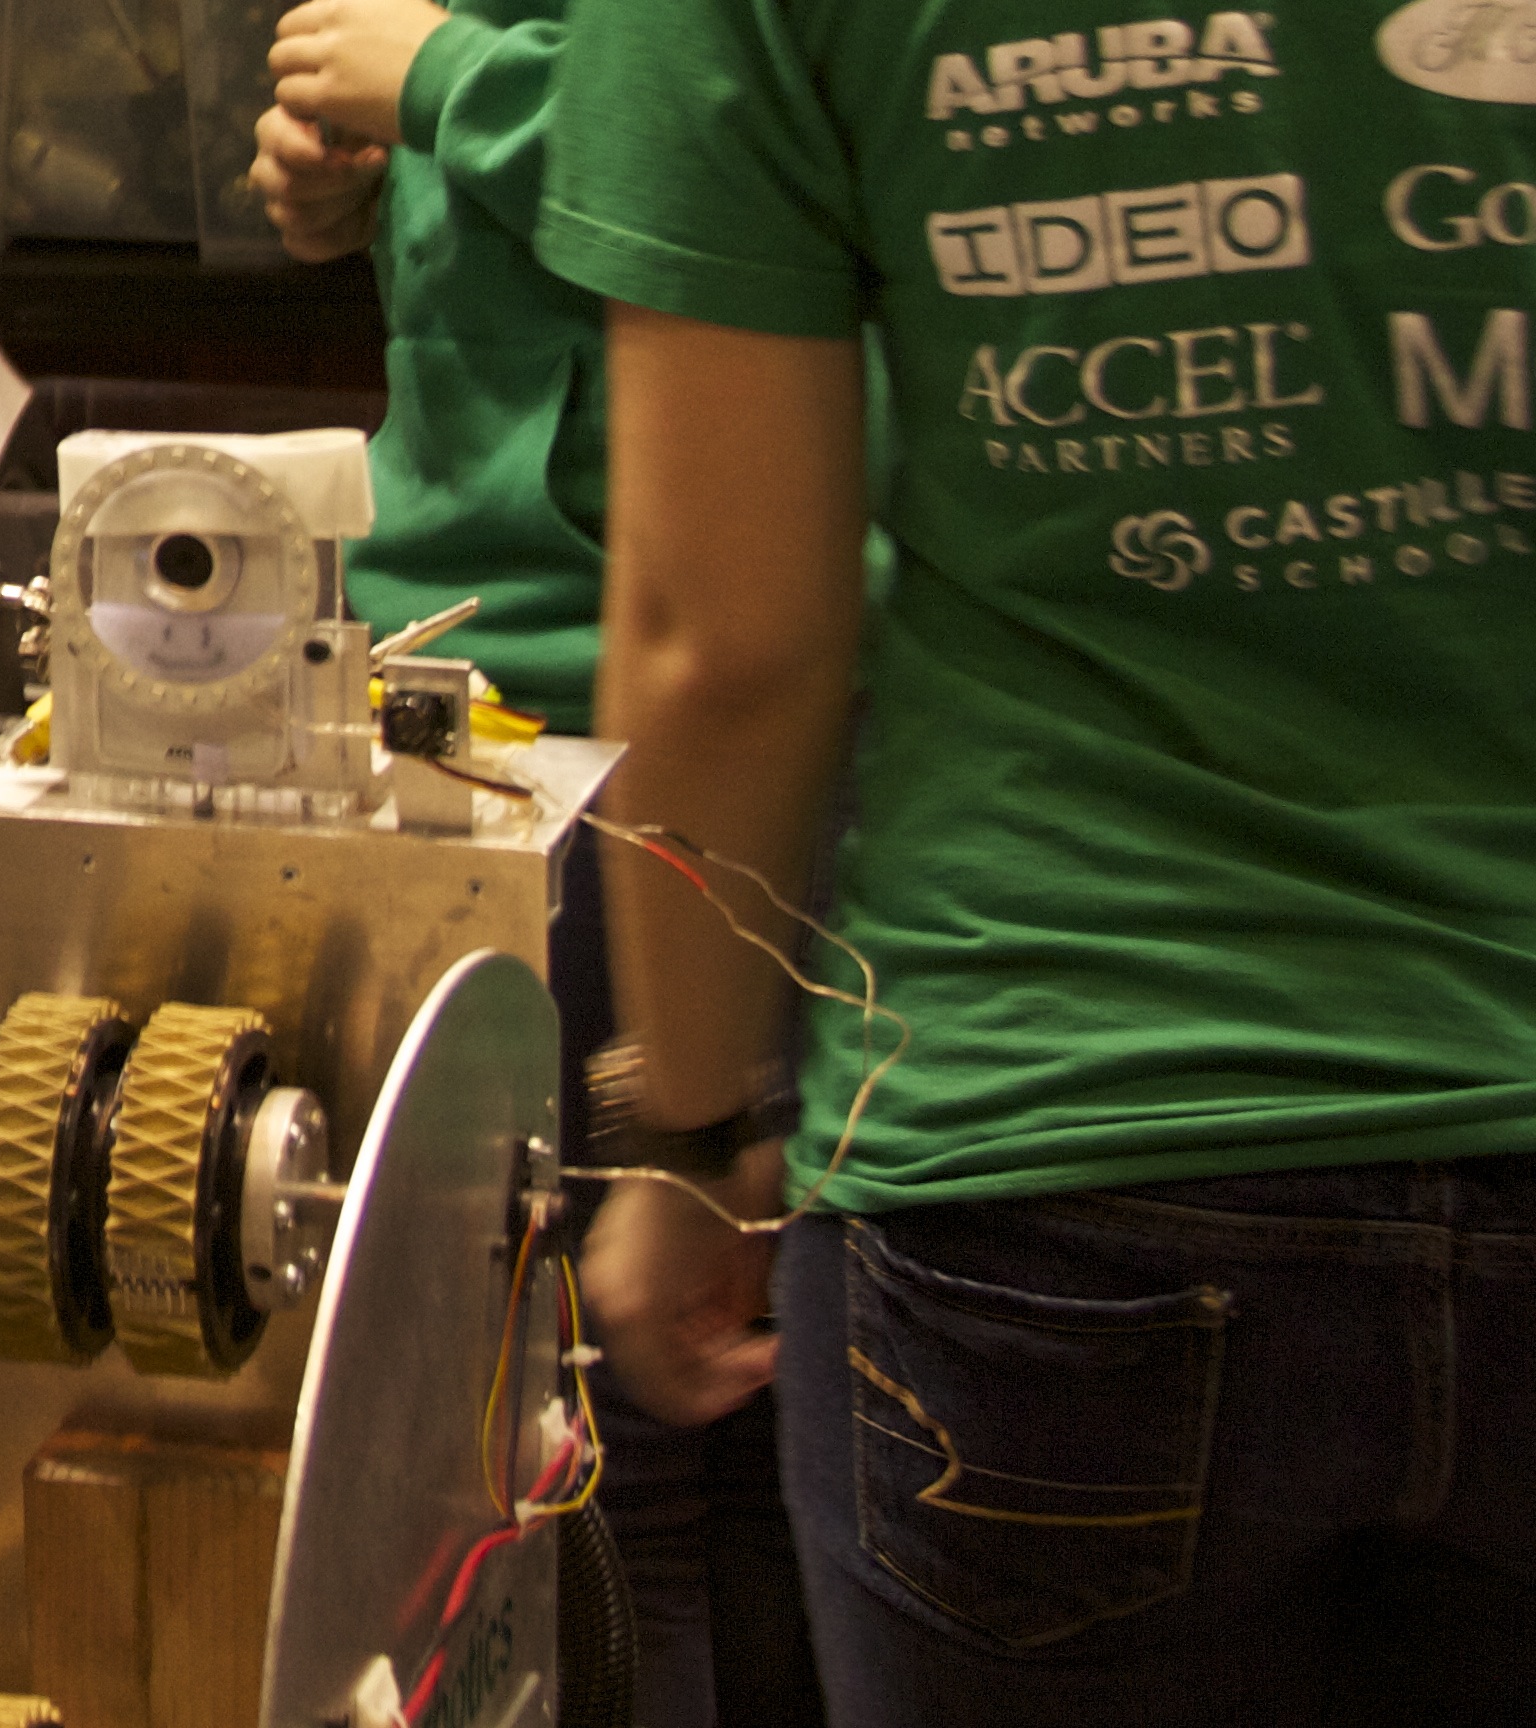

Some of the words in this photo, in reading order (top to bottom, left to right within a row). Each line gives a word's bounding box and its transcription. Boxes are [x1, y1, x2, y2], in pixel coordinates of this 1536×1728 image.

[925, 10, 1280, 121] ARUBA
[946, 87, 1264, 152] networks
[936, 184, 1295, 286] IDEO
[959, 322, 1324, 427] ACCEL
[985, 421, 1296, 474] PARTNERS
